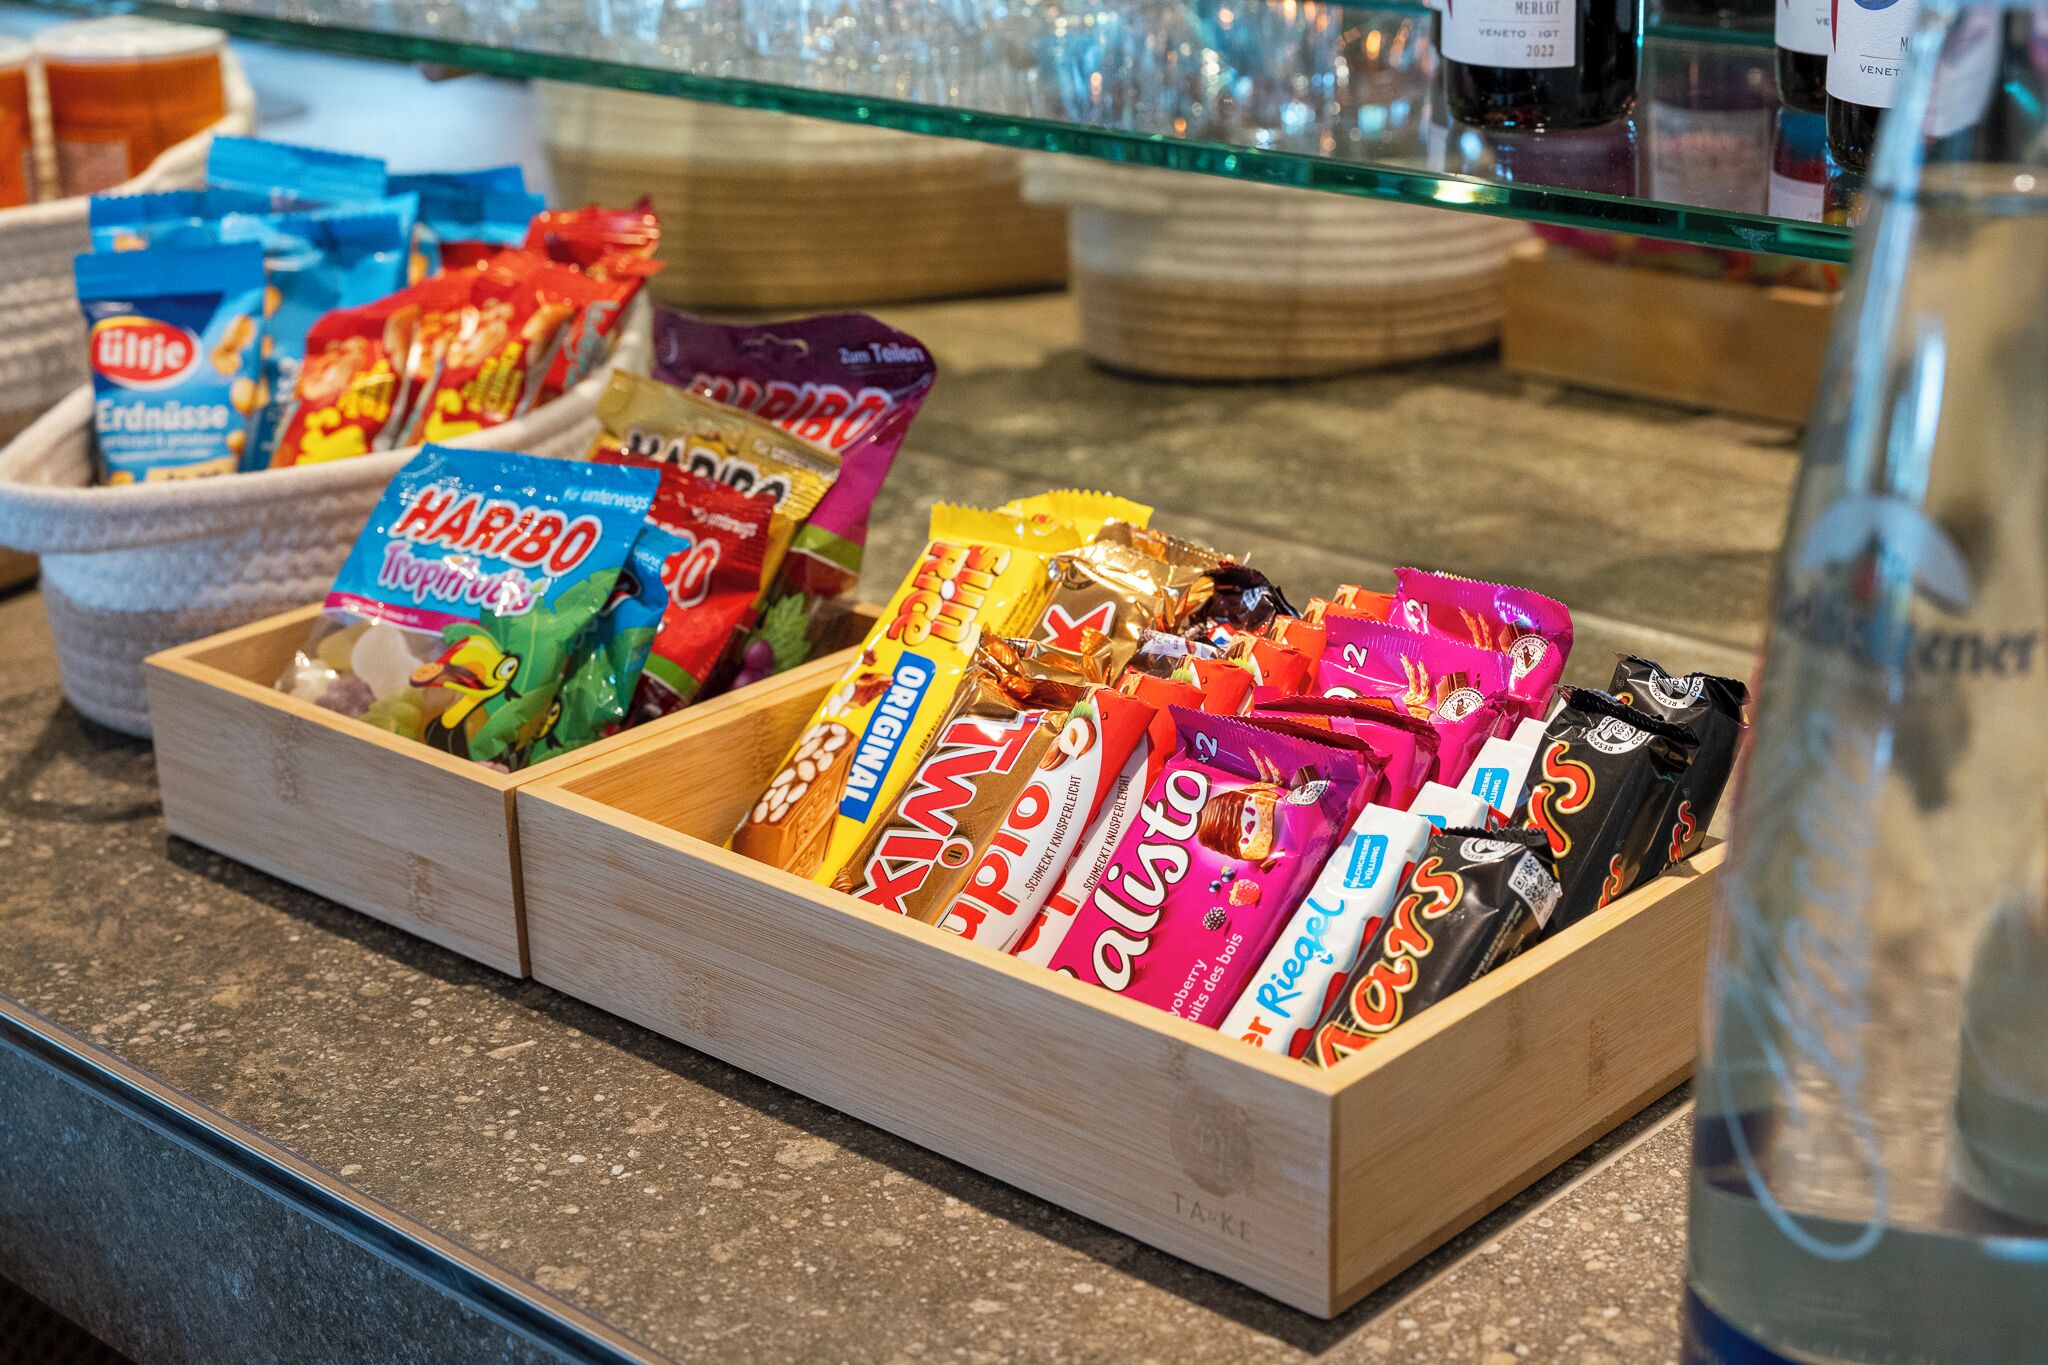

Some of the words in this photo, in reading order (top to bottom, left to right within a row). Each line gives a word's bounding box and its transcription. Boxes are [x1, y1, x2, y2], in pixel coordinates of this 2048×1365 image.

[1478, 29, 1527, 38] VENETO
[1539, 30, 1560, 38] IGT
[1515, 1, 1560, 15] MERLOT
[1526, 45, 1555, 57] 2022
[1859, 64, 1905, 77] VENET
[98, 329, 187, 374] ültje
[840, 348, 870, 364] Zum
[869, 343, 925, 363] Teilen
[97, 399, 229, 431] Erdnüsse
[388, 483, 602, 576] HARIBO
[842, 665, 926, 803] ORIGINAL
[1049, 775, 1082, 848] KNUSPERLEICHT
[1105, 775, 1130, 847] KNUSPERLEICHT
[1056, 769, 1213, 992] alisto
[1187, 993, 1210, 1022] uits
[1203, 965, 1225, 992] des
[1216, 933, 1243, 965] bois
[1256, 898, 1345, 1019] Riegel
